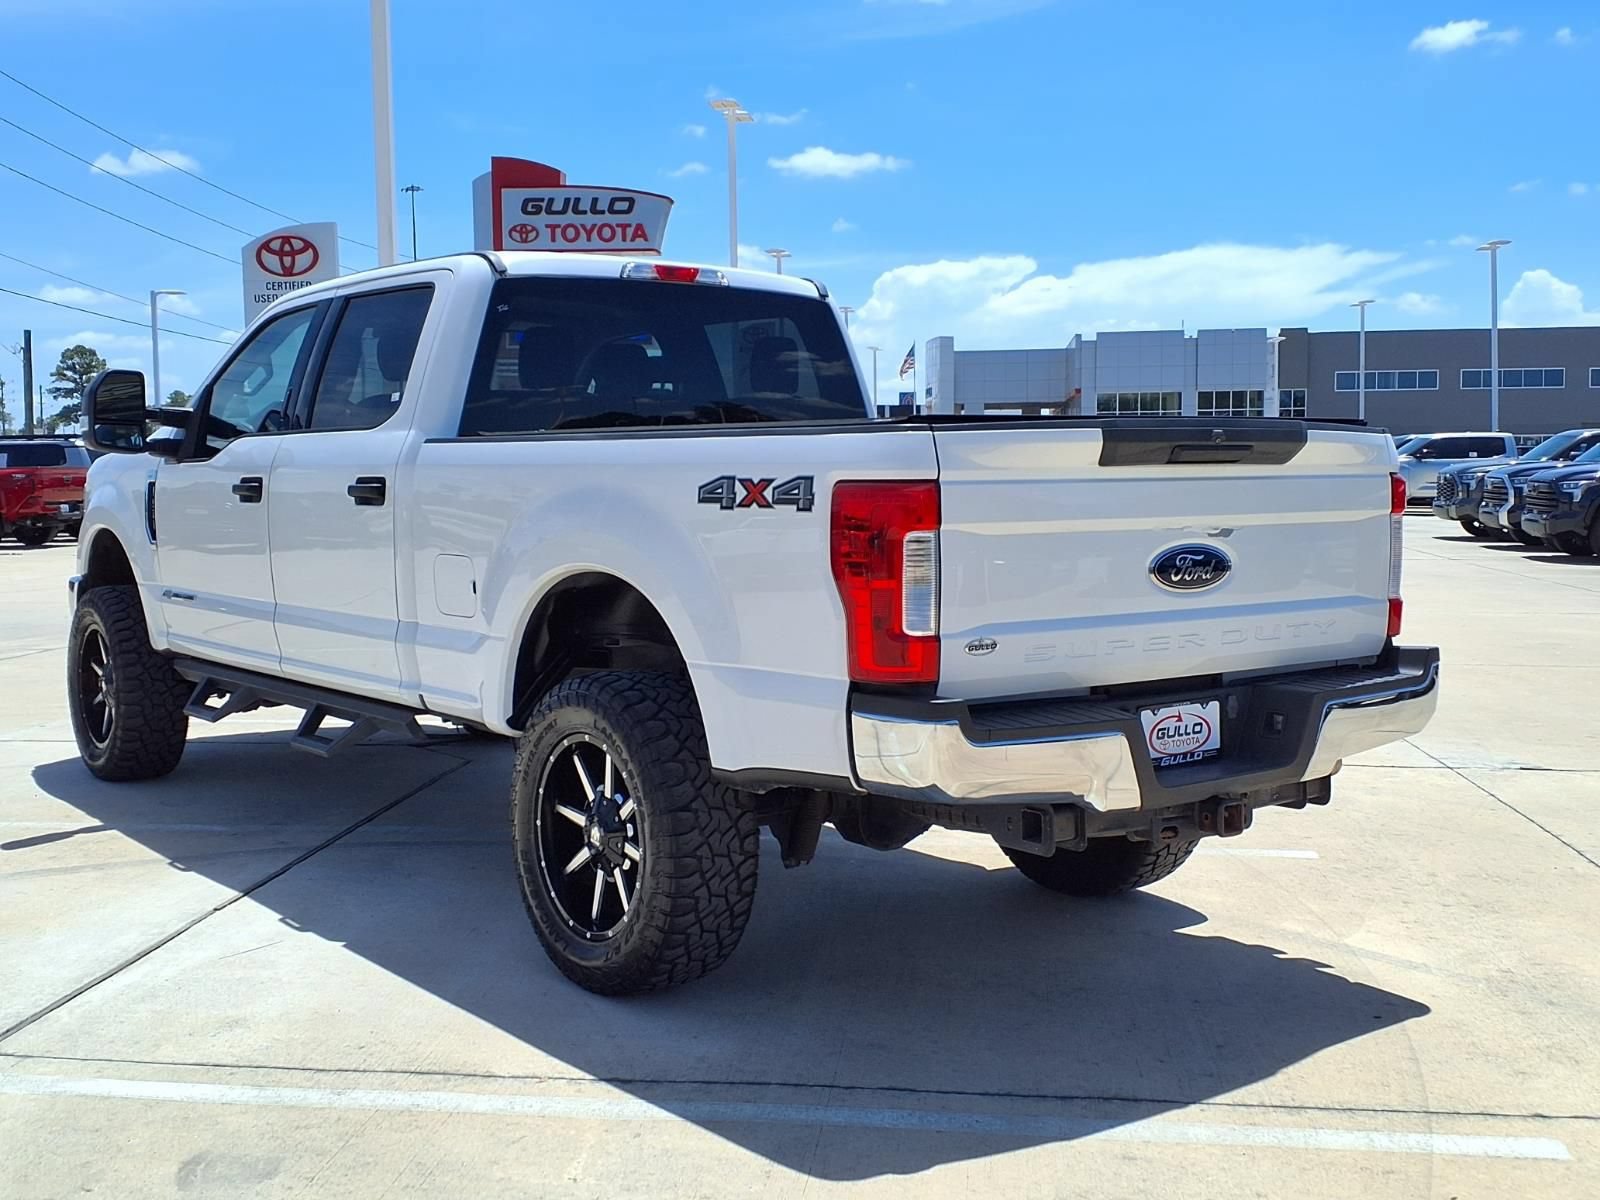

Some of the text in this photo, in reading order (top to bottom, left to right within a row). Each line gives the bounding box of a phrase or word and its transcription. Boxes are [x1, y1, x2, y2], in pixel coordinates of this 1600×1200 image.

[520, 196, 636, 216] GULLO
[544, 223, 649, 243] TOYOTA
[1171, 554, 1216, 582] Ford
[1023, 618, 1337, 663] SUPER DUTY
[1156, 722, 1204, 741] GULLO
[1171, 736, 1201, 748] TOYOTA
[1160, 750, 1204, 767] GULLO
